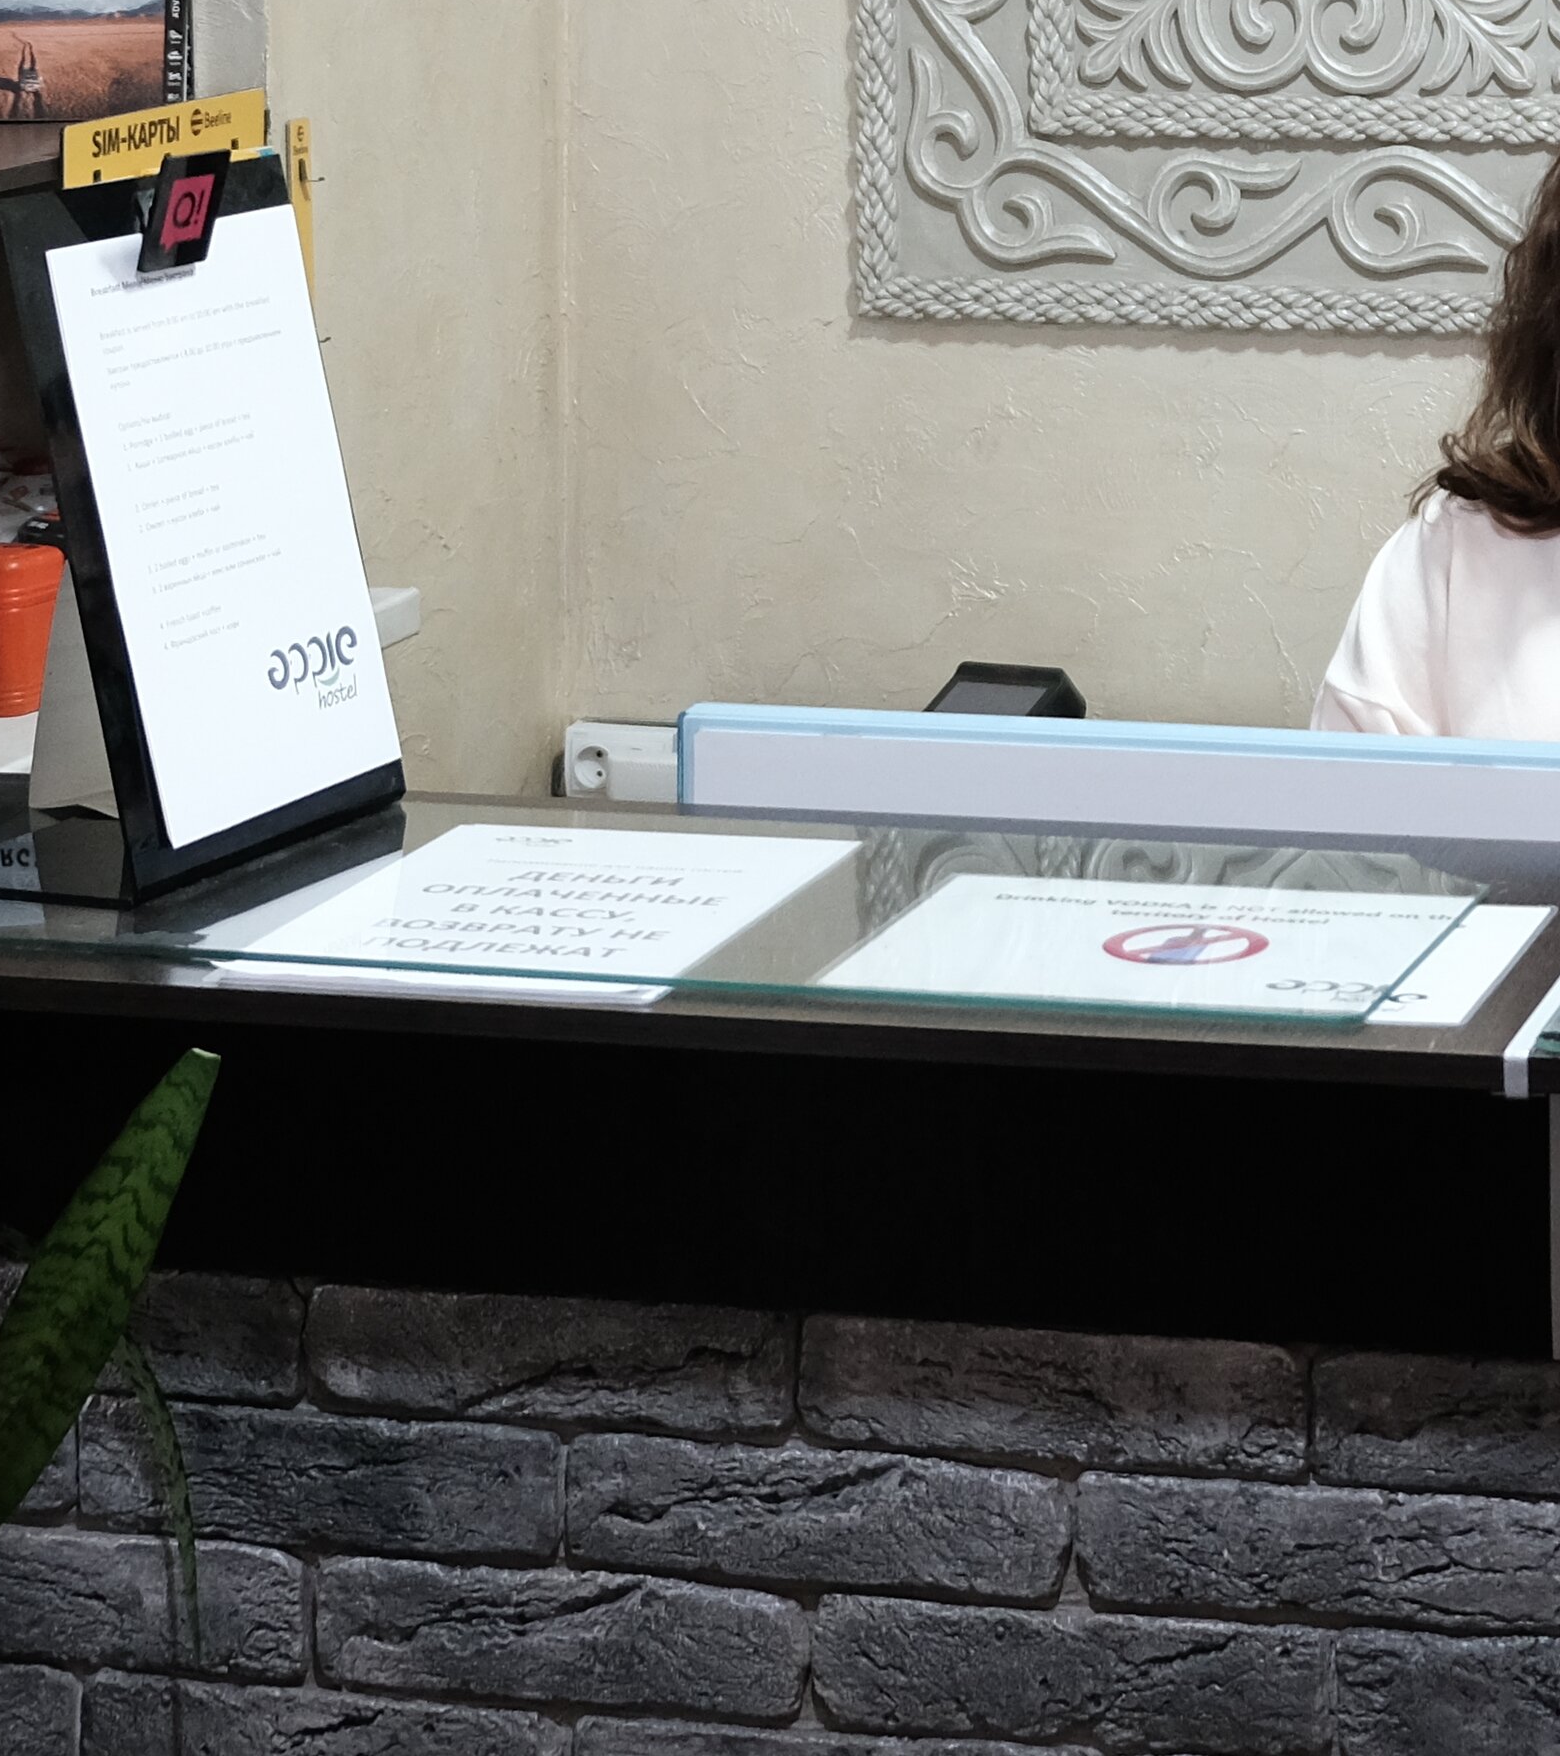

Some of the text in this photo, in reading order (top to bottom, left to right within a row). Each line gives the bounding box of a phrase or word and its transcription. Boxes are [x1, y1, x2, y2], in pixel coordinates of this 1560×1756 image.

[92, 111, 232, 158] SIM-КАРТЫ Beeline
[317, 673, 358, 710] hostel
[507, 870, 685, 887] ДЕНЬГИ
[422, 883, 730, 907] ОПЛАЧЕННЫЕ
[995, 893, 1098, 906] Drinking
[1107, 898, 1191, 911] VODKA
[1227, 904, 1278, 913] NOT
[1288, 906, 1383, 919] allowed
[1389, 912, 1419, 920] on
[450, 902, 636, 923] В КАССУ,
[1112, 909, 1331, 926] territory of Hostel
[372, 918, 671, 942] ВОЗВРАТУ НЕ
[363, 936, 628, 958] ПОДЛЕЖАТ
